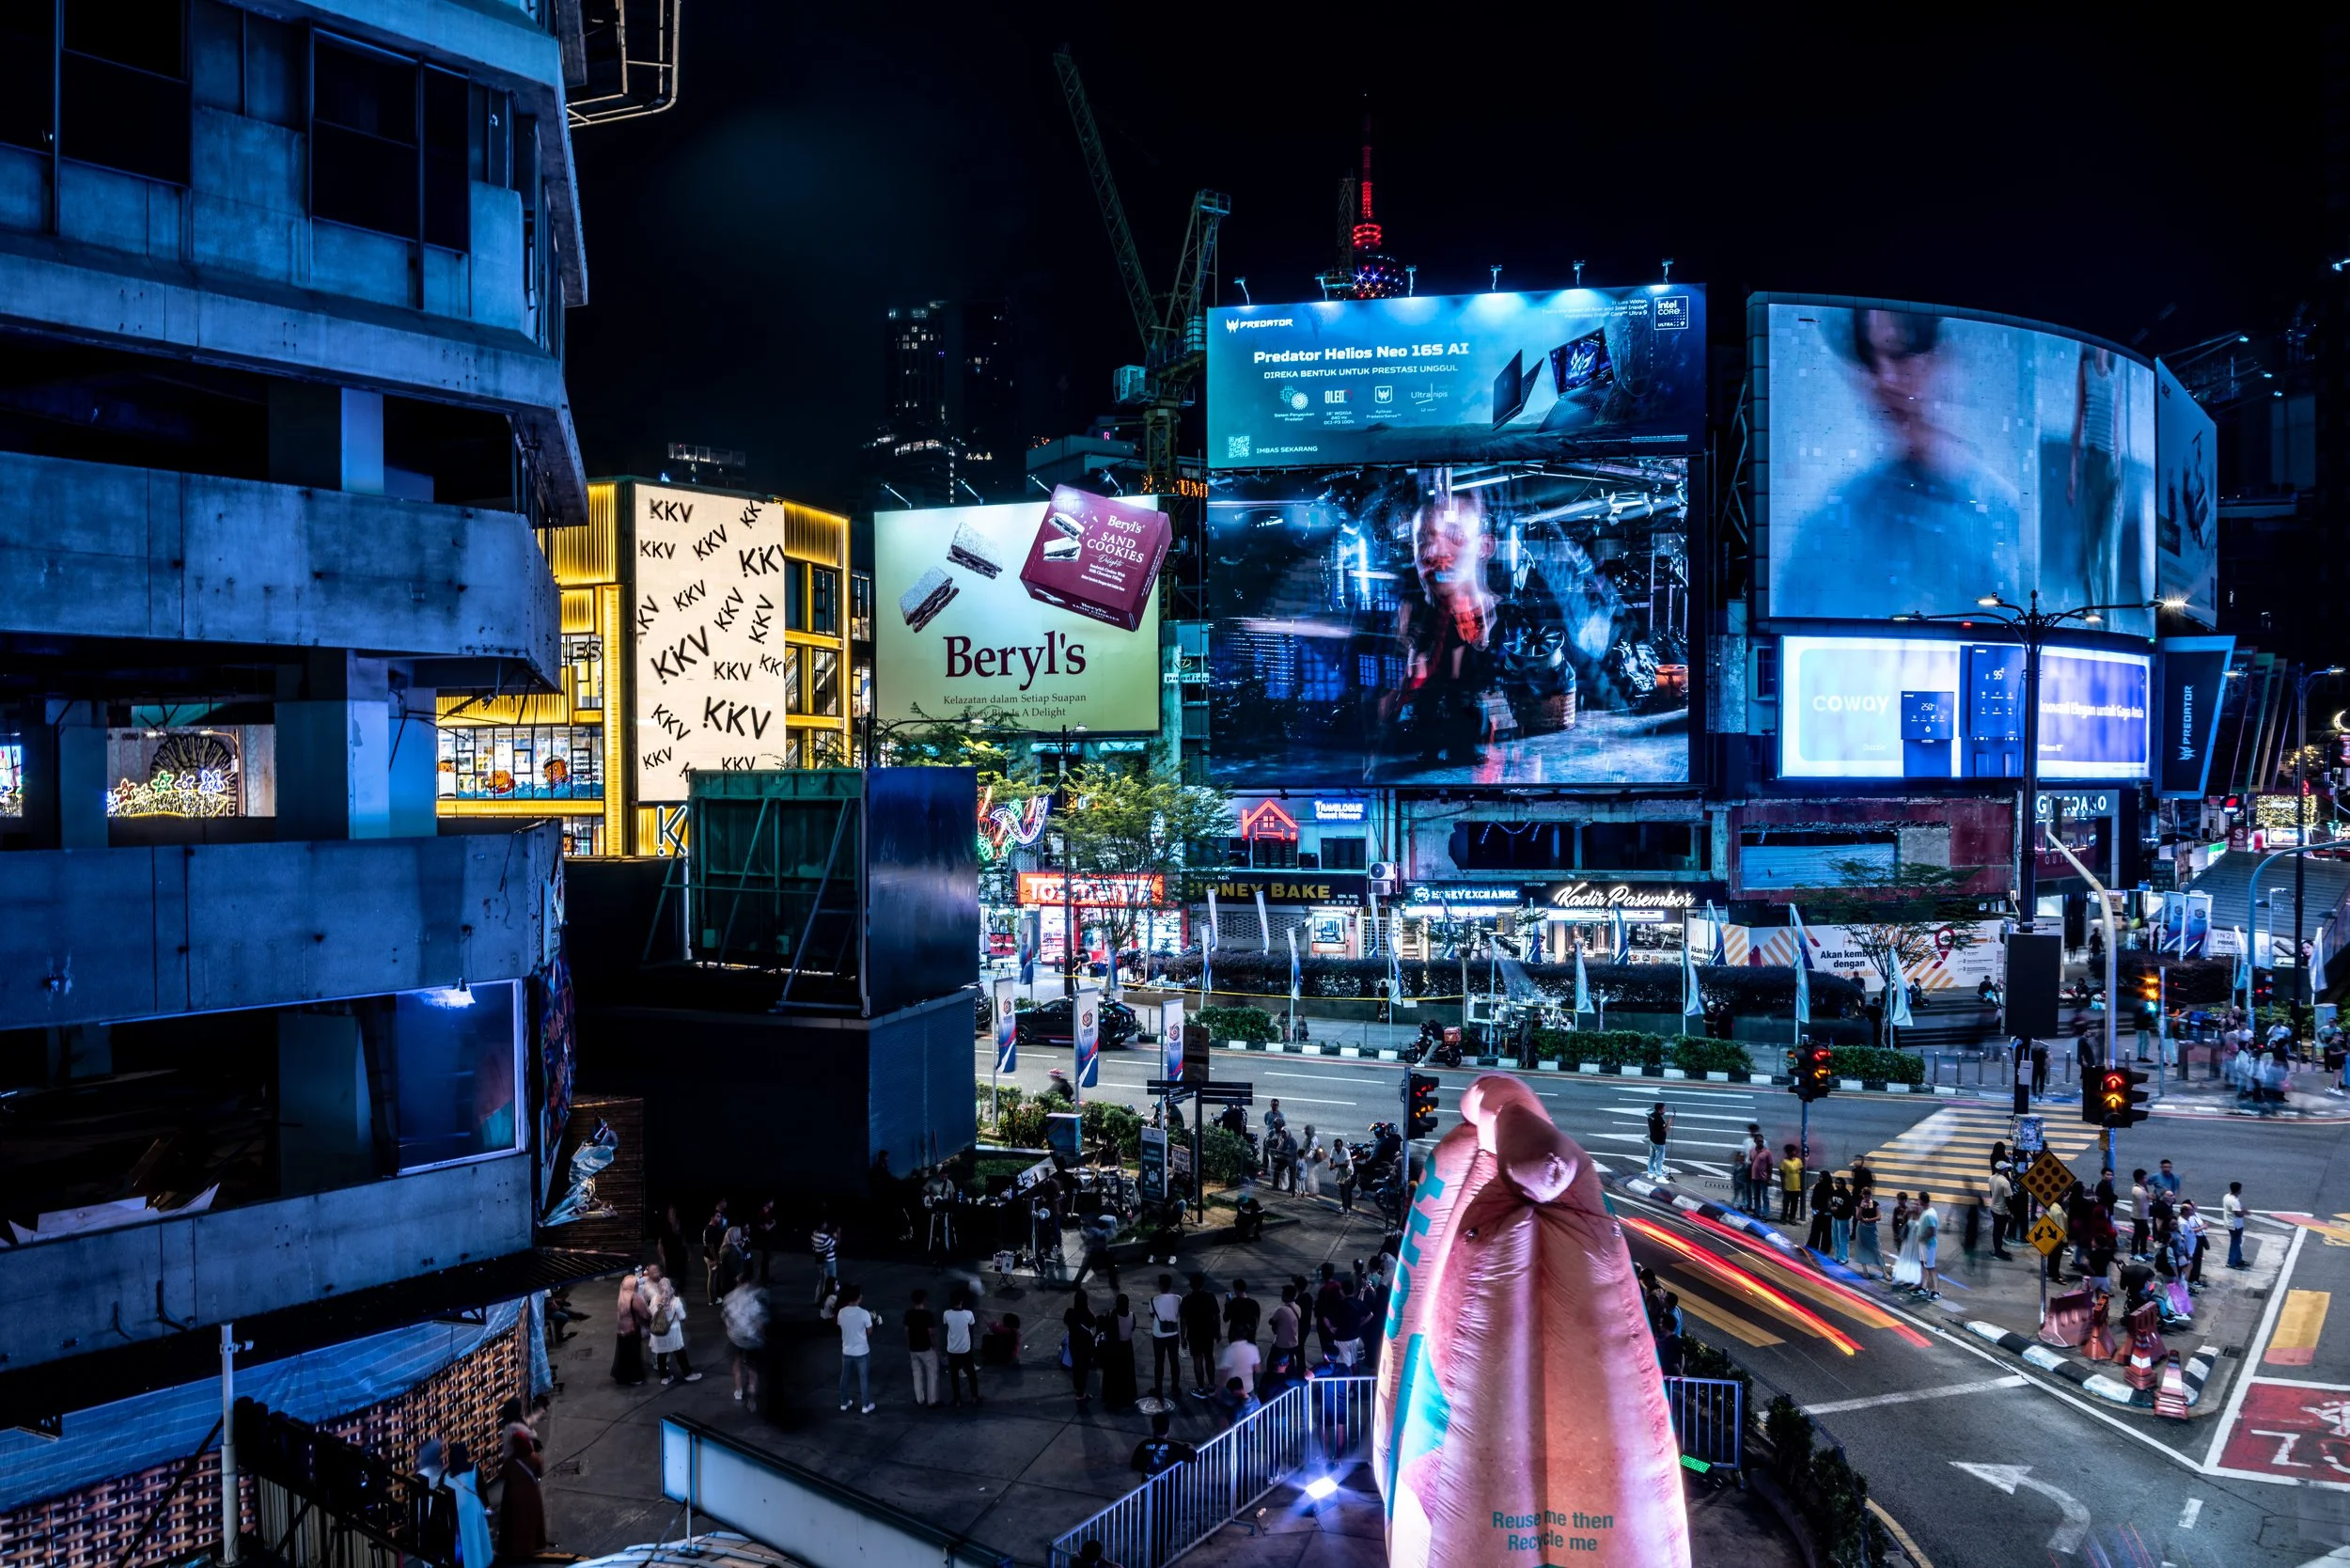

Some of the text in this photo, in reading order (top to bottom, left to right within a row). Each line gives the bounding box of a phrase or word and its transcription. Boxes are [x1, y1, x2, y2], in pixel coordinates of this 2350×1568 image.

[1657, 300, 1677, 309] intel
[1240, 318, 1293, 329] PREDATOR
[1254, 342, 1469, 364] Predator Helios Neo 16S AI
[1263, 364, 1459, 380] DIREKA BENTUK UNTUK PRESTASI UNGGUL
[1324, 390, 1346, 404] OLED
[1280, 445, 1318, 454] SEKARANG
[650, 497, 694, 524] KKV
[740, 499, 765, 529] KK
[1107, 515, 1142, 534] Beryl's
[640, 540, 676, 559] KKV
[693, 524, 727, 561] KKV
[1101, 531, 1136, 549] SAND
[1087, 539, 1144, 563] COOKIES
[673, 579, 706, 612] KKV
[713, 587, 744, 633] KKV
[748, 593, 774, 645] KKV
[650, 624, 710, 685] KKV
[943, 630, 1087, 691] Beryl's
[713, 661, 752, 681] KKV
[944, 694, 1087, 705] Kelazatan dalam Setiap Suapan
[1812, 695, 1889, 715] coway
[650, 703, 691, 741] KKV
[702, 696, 772, 740] KKV
[1022, 709, 1029, 717] A
[1032, 707, 1066, 718] Delight
[2183, 684, 2195, 745] PREDATOR
[642, 745, 672, 770] KKV
[1271, 882, 1331, 899] BAKE
[1554, 882, 1696, 907] Kadir Pasembor
[1820, 950, 1842, 959] Akan
[1833, 960, 1866, 970] dengan
[1492, 1510, 1614, 1529] Reuse me then
[1508, 1529, 1597, 1551] Recycle me
